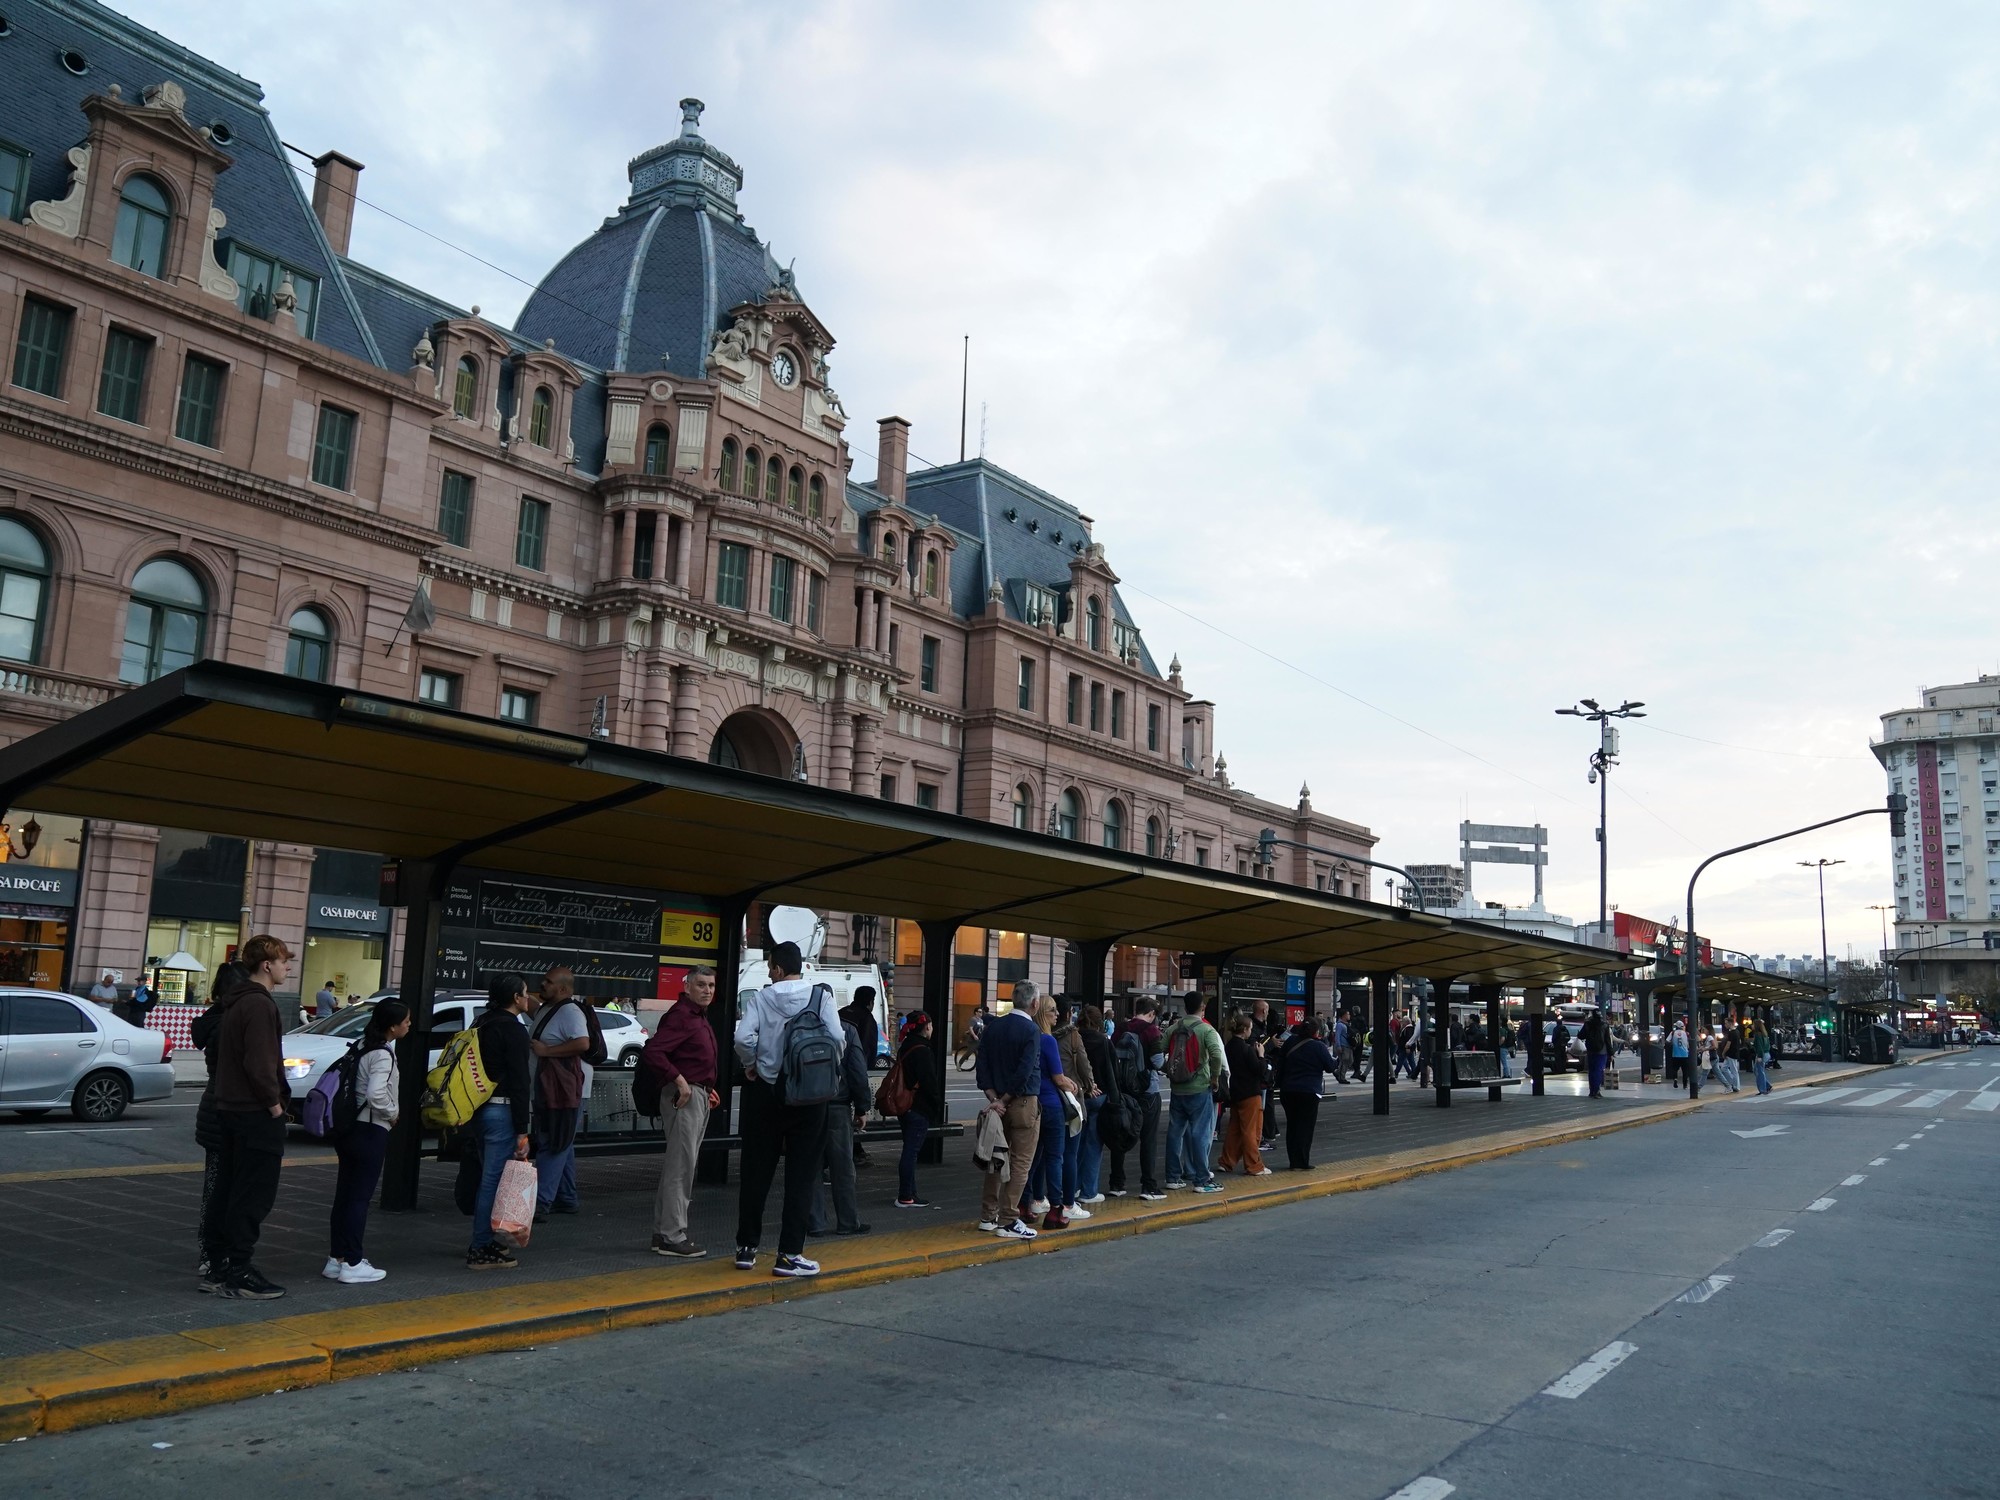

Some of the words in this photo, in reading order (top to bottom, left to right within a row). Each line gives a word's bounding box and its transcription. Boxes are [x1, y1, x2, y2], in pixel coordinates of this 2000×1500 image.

[721, 650, 756, 674] 1885
[778, 667, 810, 688] 1907
[362, 702, 376, 713] 51
[408, 712, 423, 724] 98
[516, 734, 578, 753] Constitución
[1923, 750, 1935, 809] PALACE
[1909, 777, 1925, 909] CONSTITUCION
[383, 871, 396, 882] 100
[1925, 825, 1941, 908] HOTEL
[30, 879, 61, 892] CAFÉ
[320, 906, 342, 917] CASA
[356, 909, 378, 921] CAFÉ
[693, 921, 713, 942] 98
[1297, 979, 1305, 992] 51
[1294, 1009, 1305, 1022] 168
